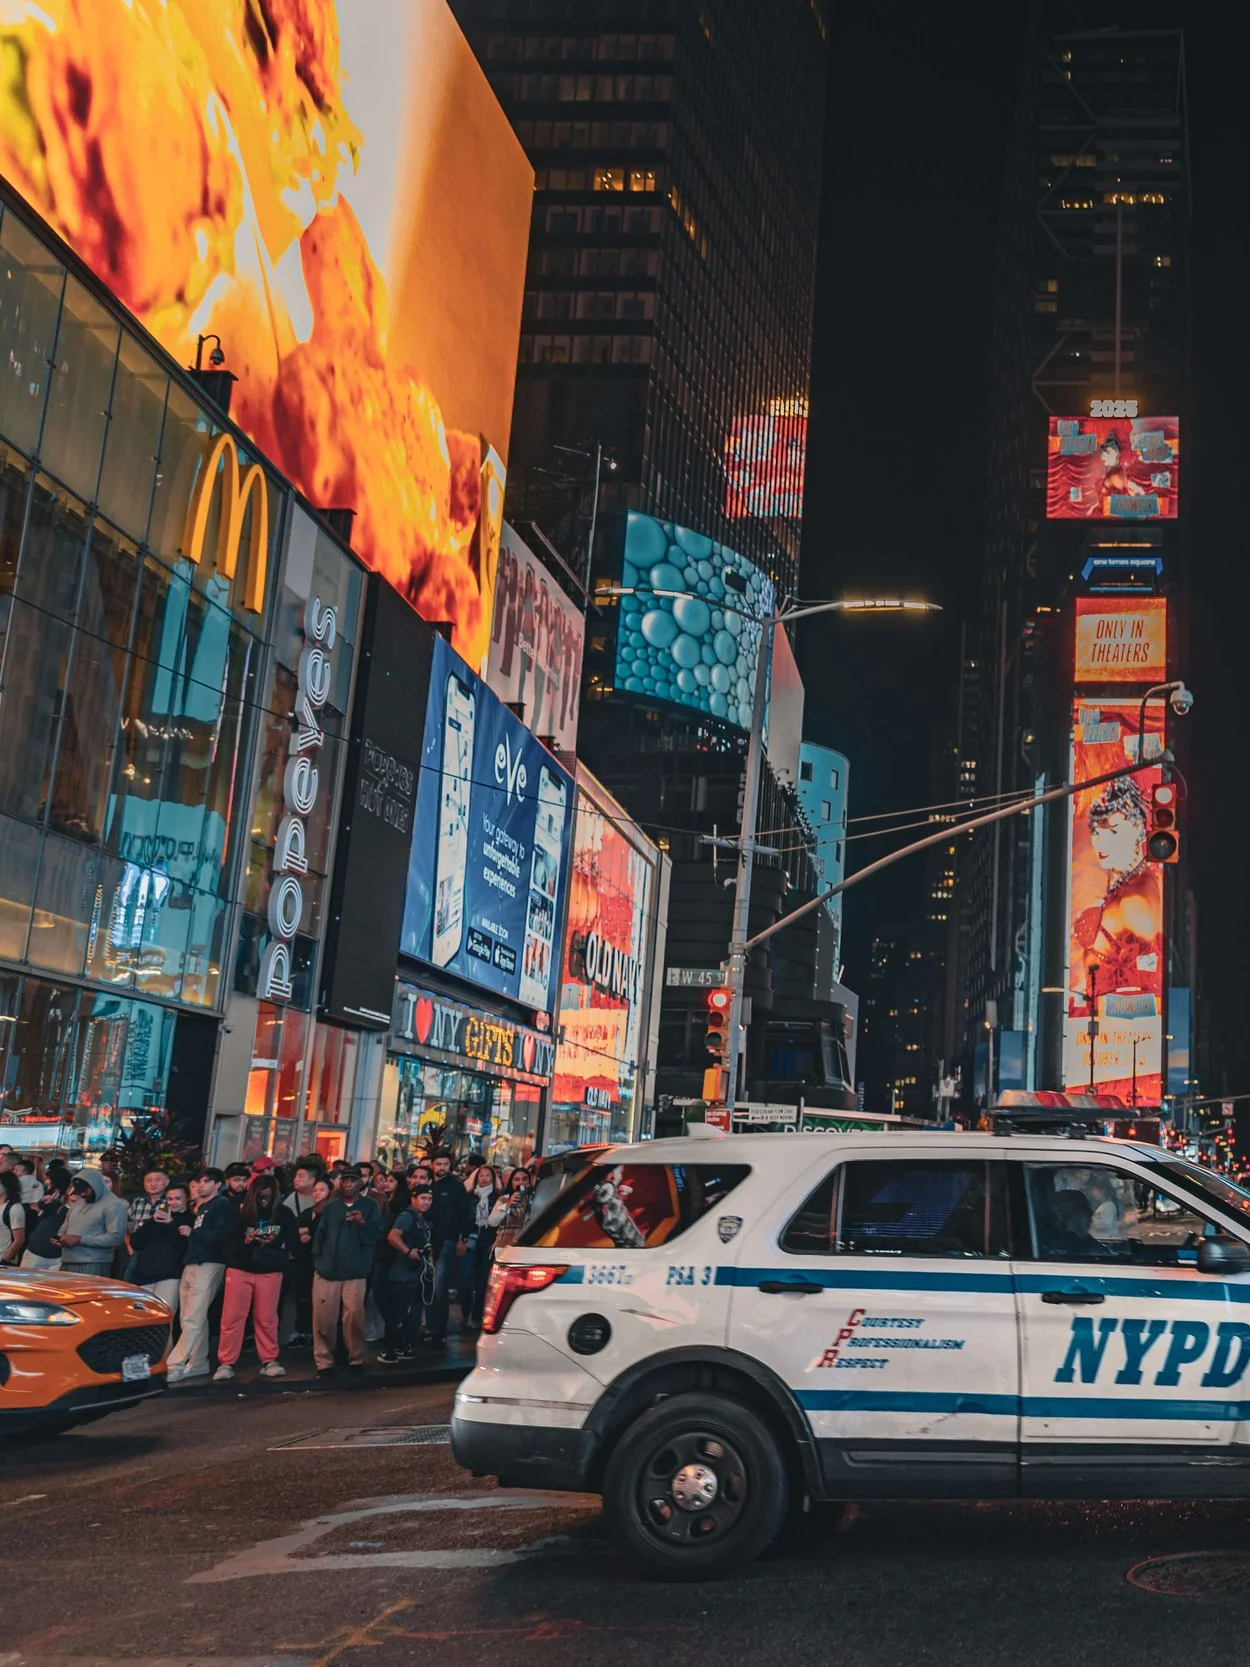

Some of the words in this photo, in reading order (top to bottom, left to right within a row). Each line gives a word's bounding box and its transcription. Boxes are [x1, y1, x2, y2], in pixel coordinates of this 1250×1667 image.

[1090, 400, 1138, 417] 2025
[1096, 619, 1127, 640] ONLY
[1130, 619, 1144, 639] IN
[1091, 642, 1150, 664] THEATERS
[482, 812, 496, 839] Your
[586, 930, 612, 988] OLD
[612, 949, 643, 1005] NAVY
[682, 970, 694, 985] W
[698, 971, 712, 985] 45
[465, 1016, 515, 1067] GIFTS
[665, 1265, 695, 1286] PSA
[701, 1265, 713, 1286] 3
[847, 1308, 926, 1329] COURTESY
[832, 1328, 966, 1350] PROFESSIONALISM
[817, 1349, 891, 1369] RESPECT
